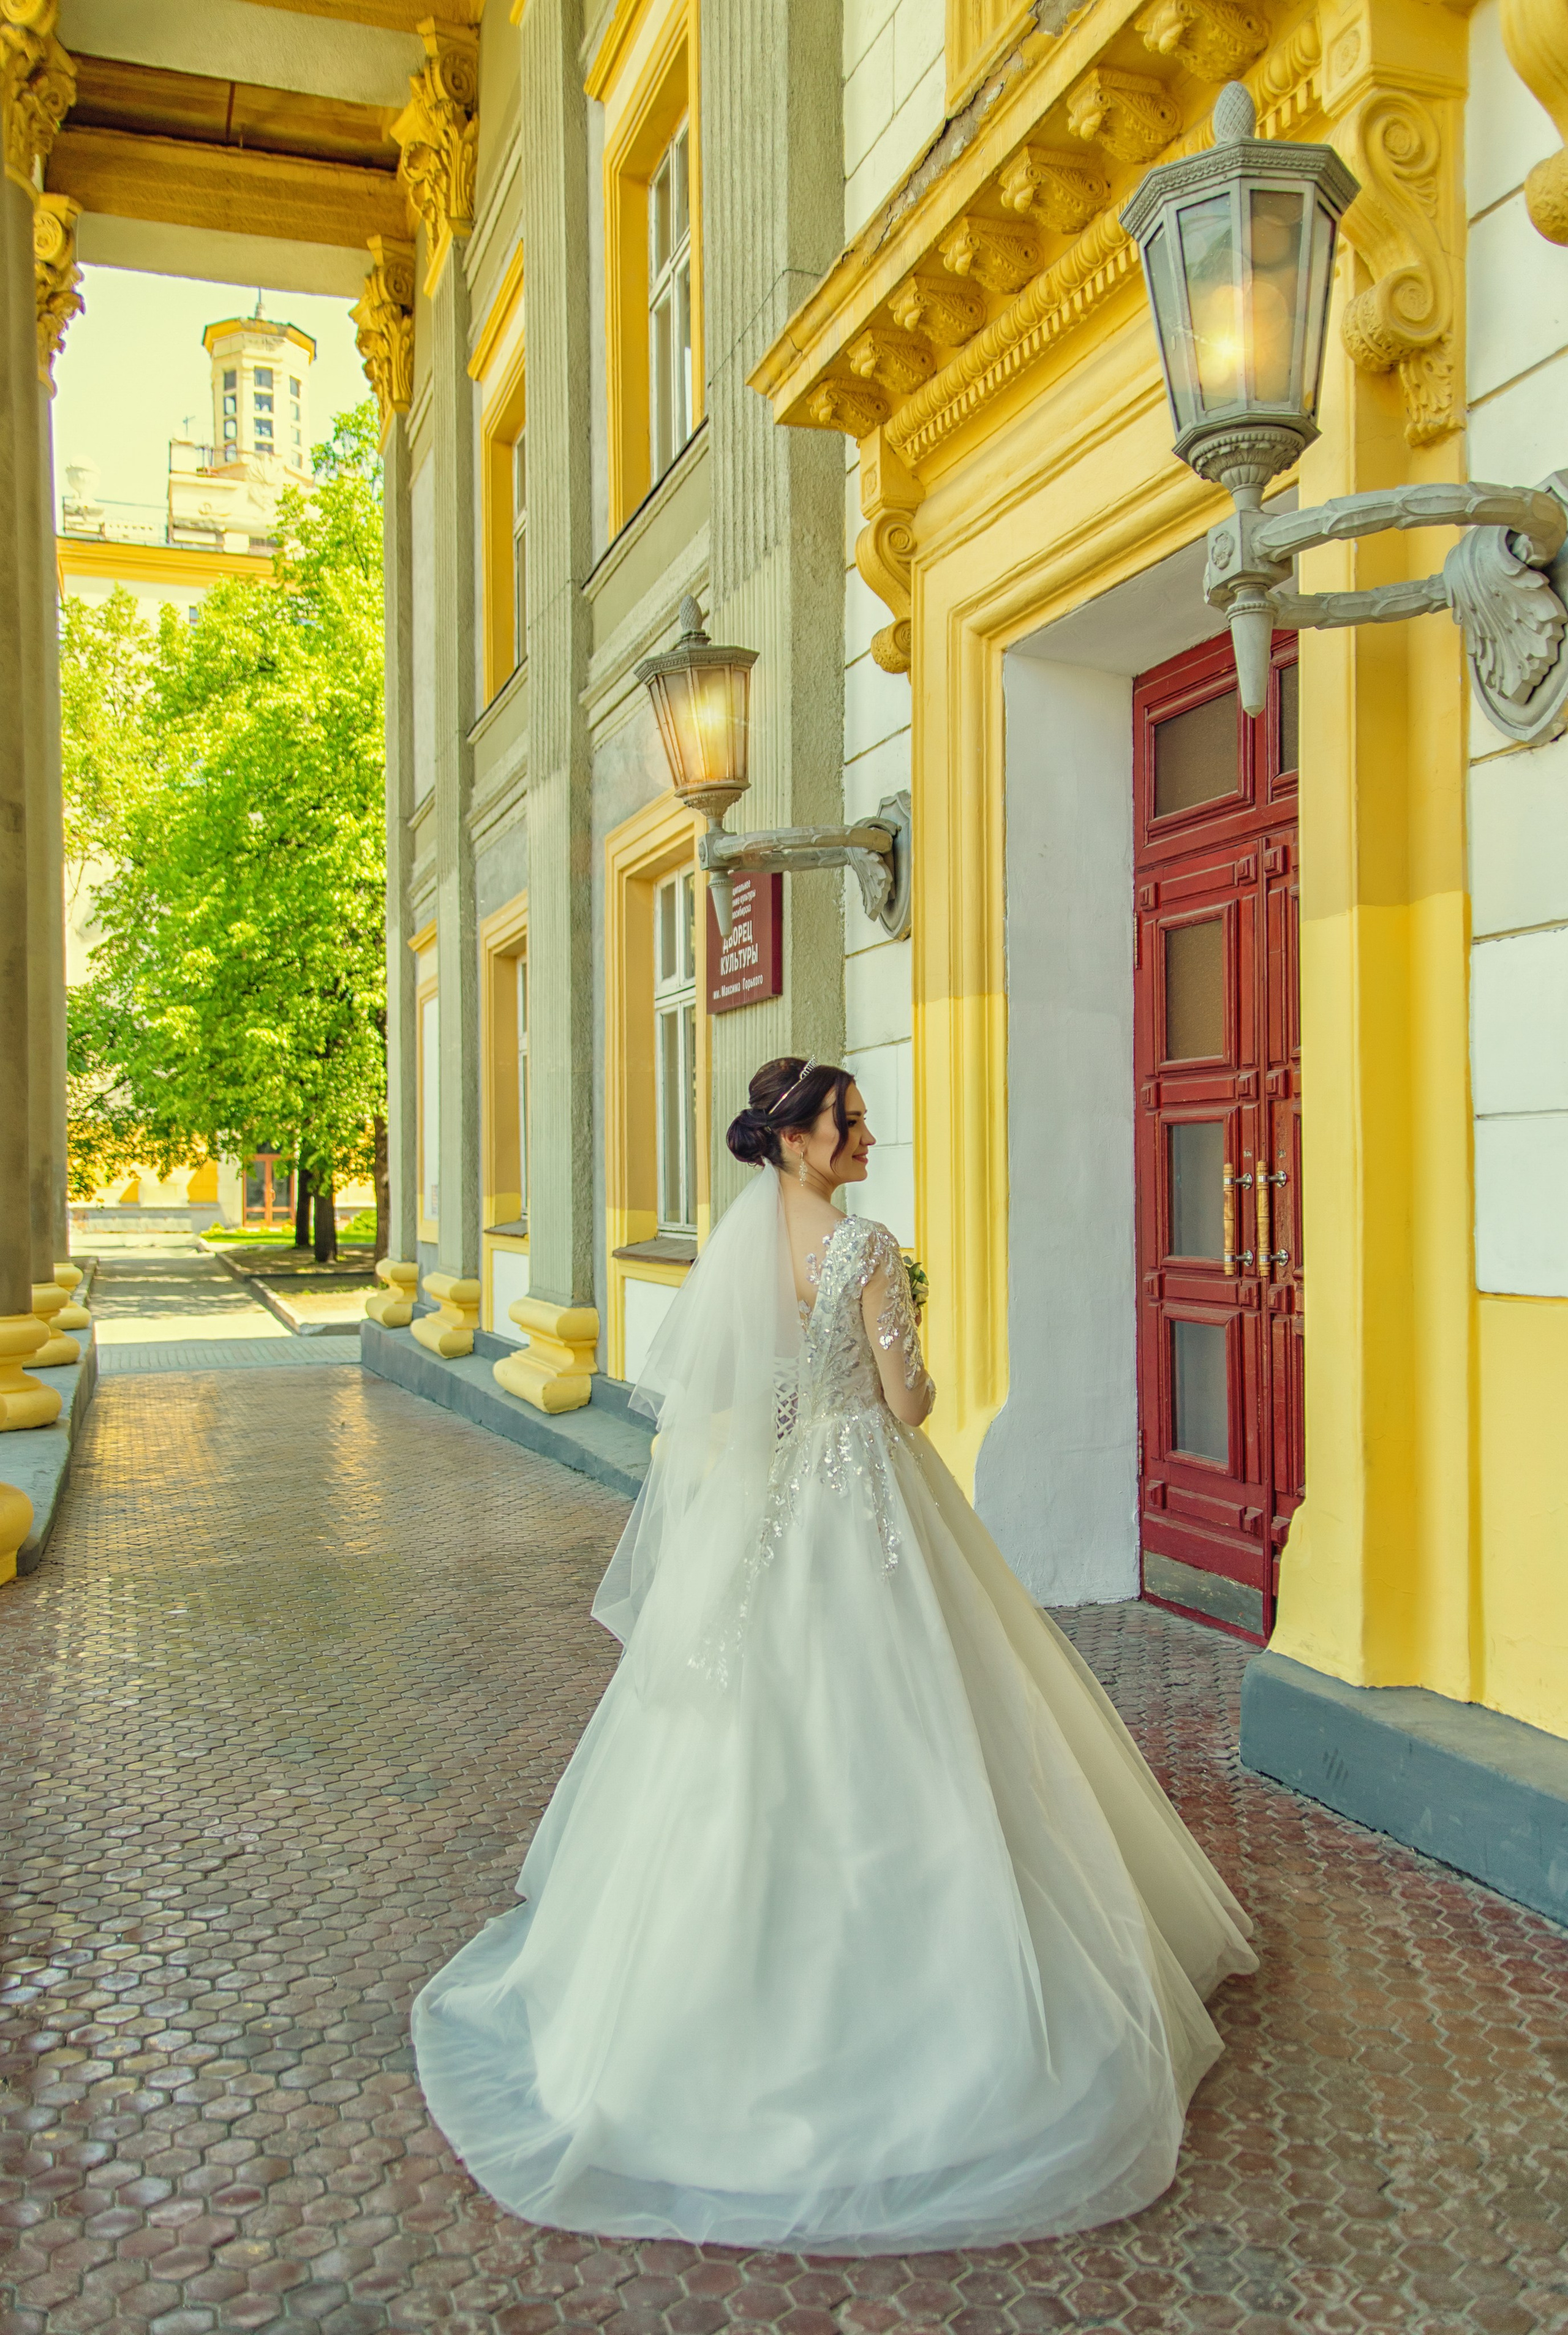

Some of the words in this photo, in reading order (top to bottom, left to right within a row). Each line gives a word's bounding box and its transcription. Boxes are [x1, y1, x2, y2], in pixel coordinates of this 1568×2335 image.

[740, 889, 756, 905] культуры
[723, 920, 753, 954] ДВОРЕЦ
[721, 943, 758, 976] КУЛЬТУРЫ
[713, 990, 722, 1000] им.
[722, 984, 741, 997] Максима
[742, 975, 763, 991] Горького
